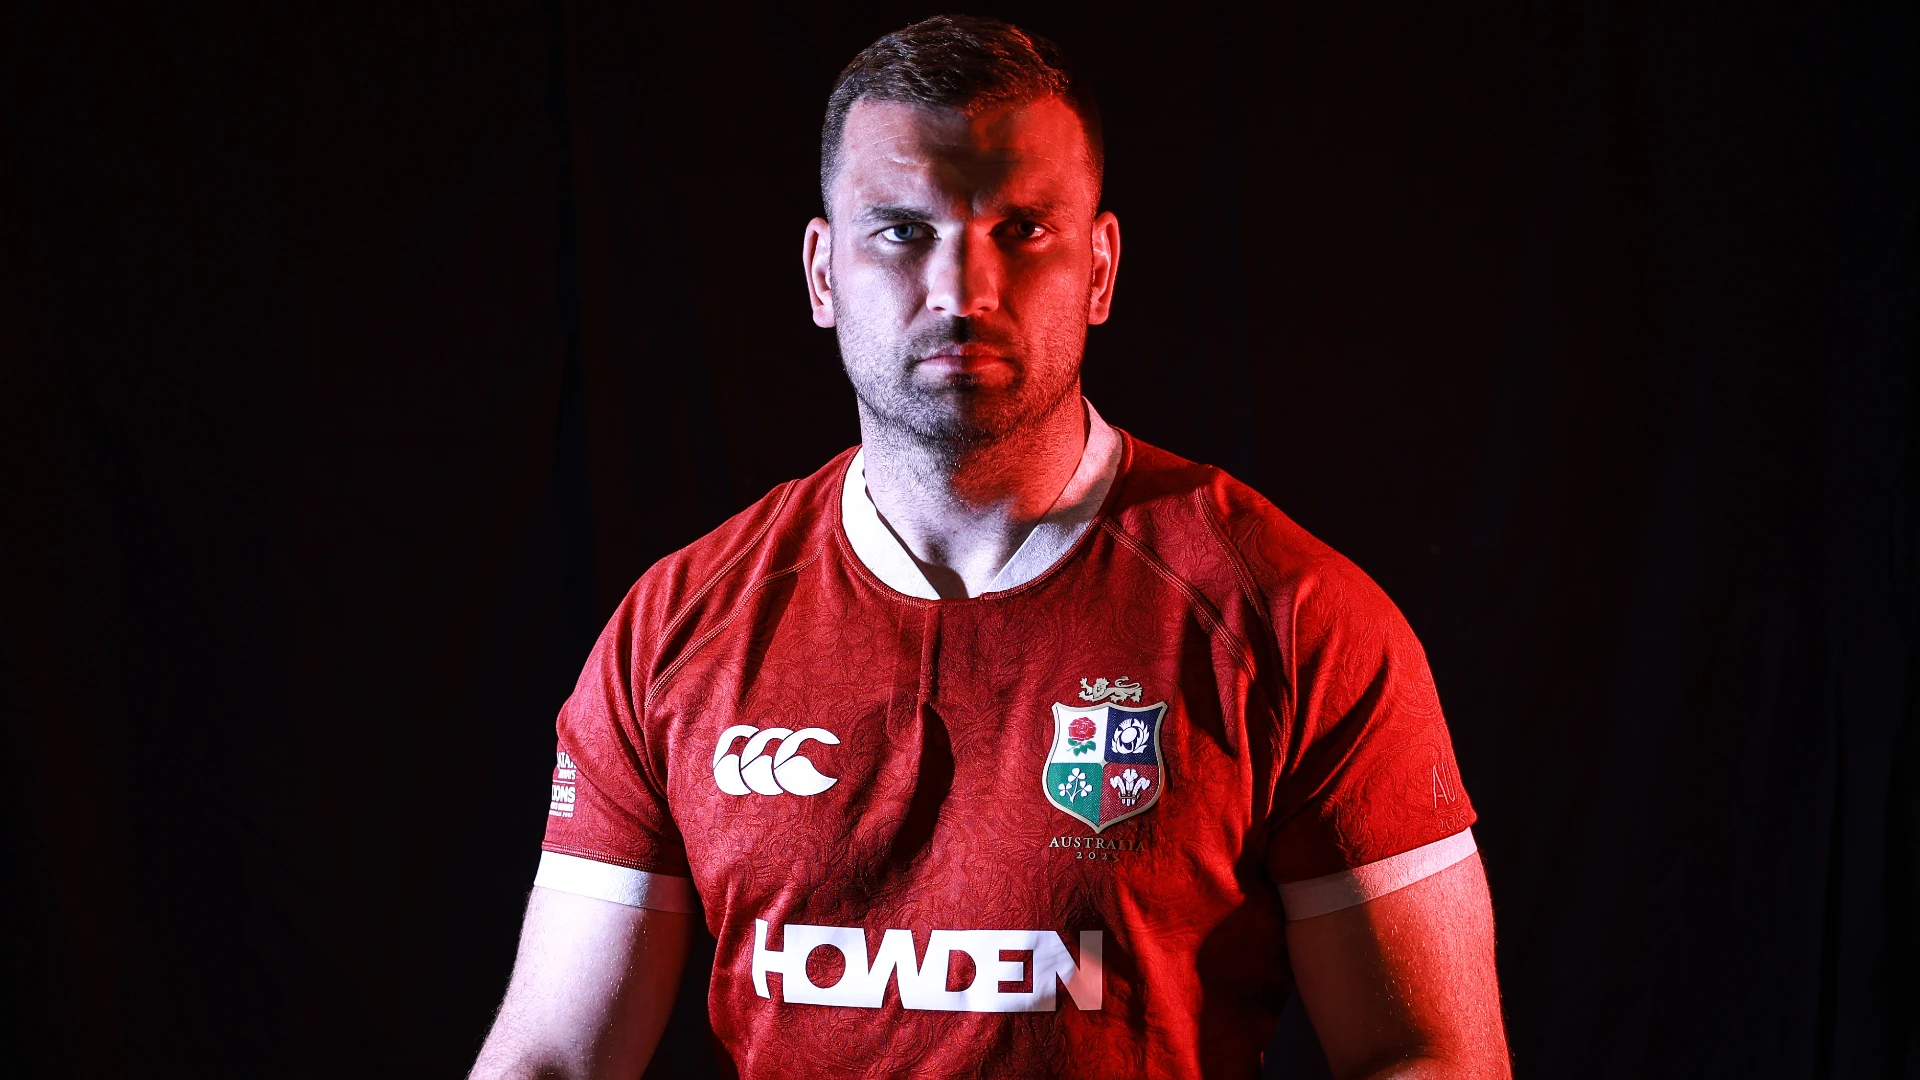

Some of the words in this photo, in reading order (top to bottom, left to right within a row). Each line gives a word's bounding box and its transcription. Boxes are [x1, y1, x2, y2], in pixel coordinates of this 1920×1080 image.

[1048, 836, 1147, 853] AUSTRALIA
[1076, 850, 1120, 863] 2025
[751, 918, 1103, 1012] HOWDEN
